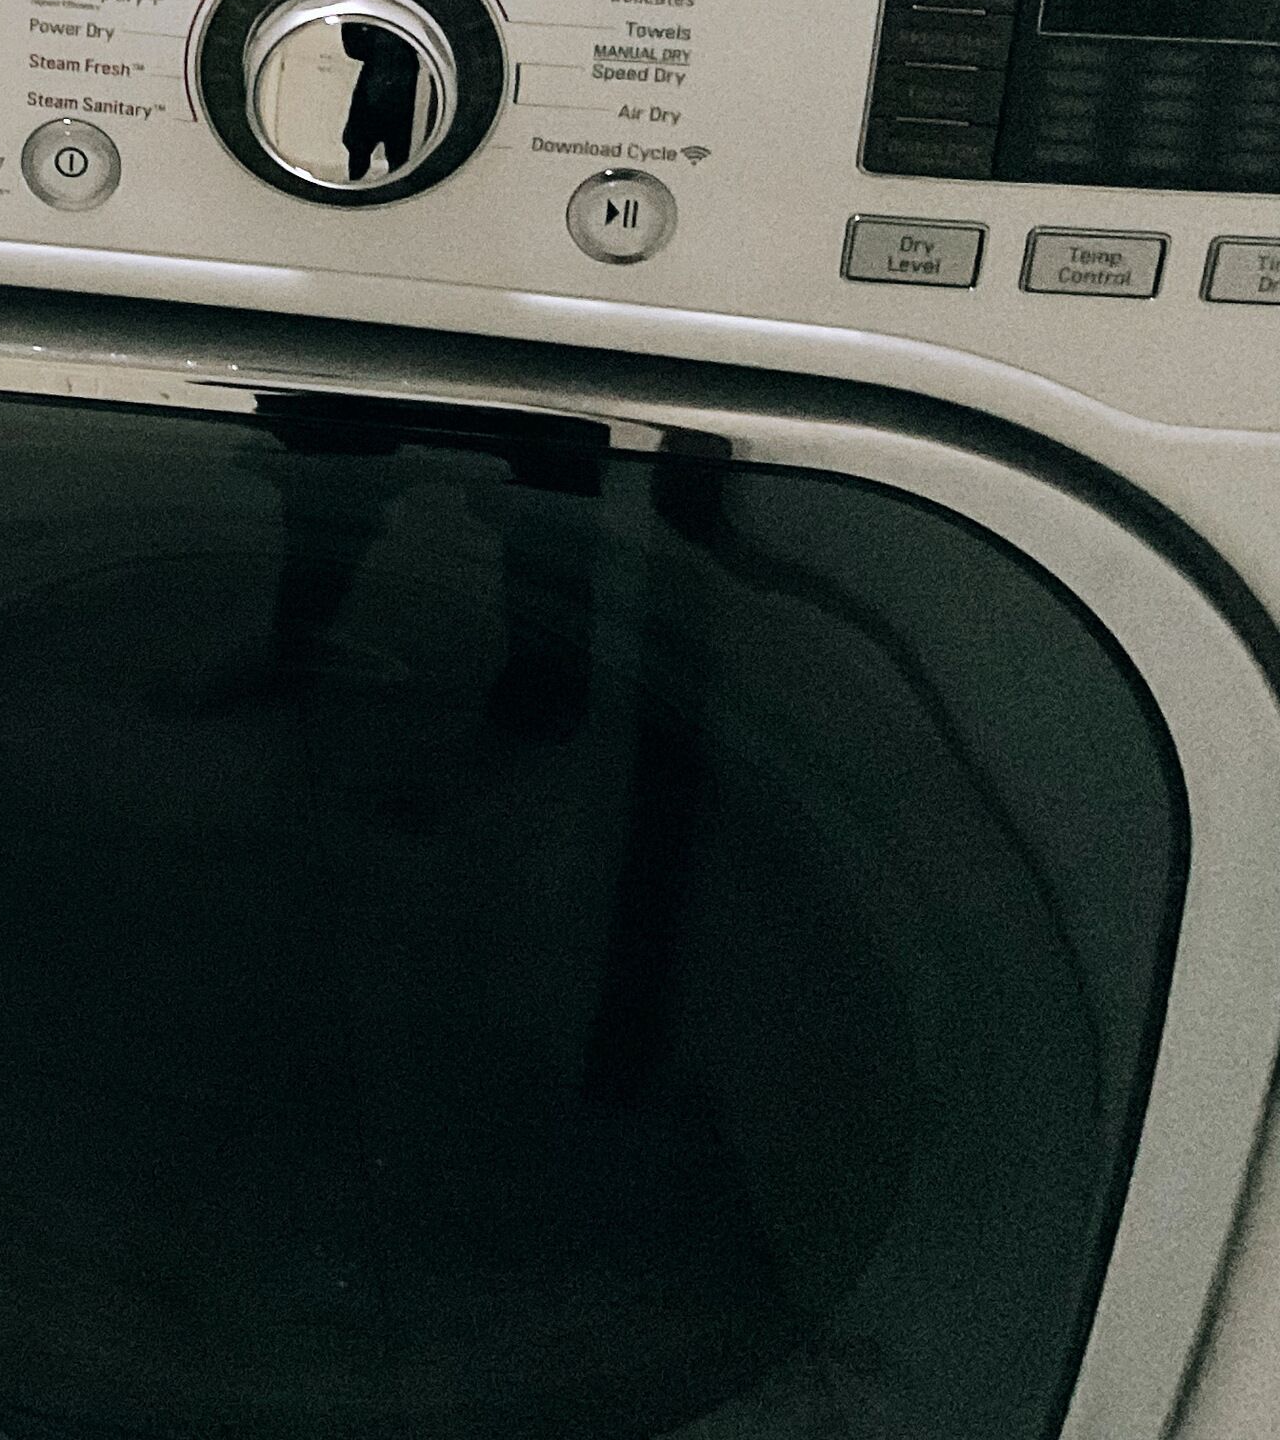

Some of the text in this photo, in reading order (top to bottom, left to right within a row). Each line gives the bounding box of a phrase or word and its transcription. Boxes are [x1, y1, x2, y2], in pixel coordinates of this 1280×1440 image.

[29, 17, 115, 43] Power Dry
[625, 20, 691, 41] Towels
[28, 53, 81, 72] Steam
[593, 44, 691, 63] MANUAL DRY
[591, 63, 687, 87] Speed Dry
[26, 91, 78, 110] Steam
[618, 105, 682, 126] Air Dry
[531, 136, 678, 164] Download Cycle
[899, 234, 936, 256] Dry
[887, 255, 942, 275] Level
[1069, 245, 1123, 269] Temp
[1058, 267, 1133, 288] Control
